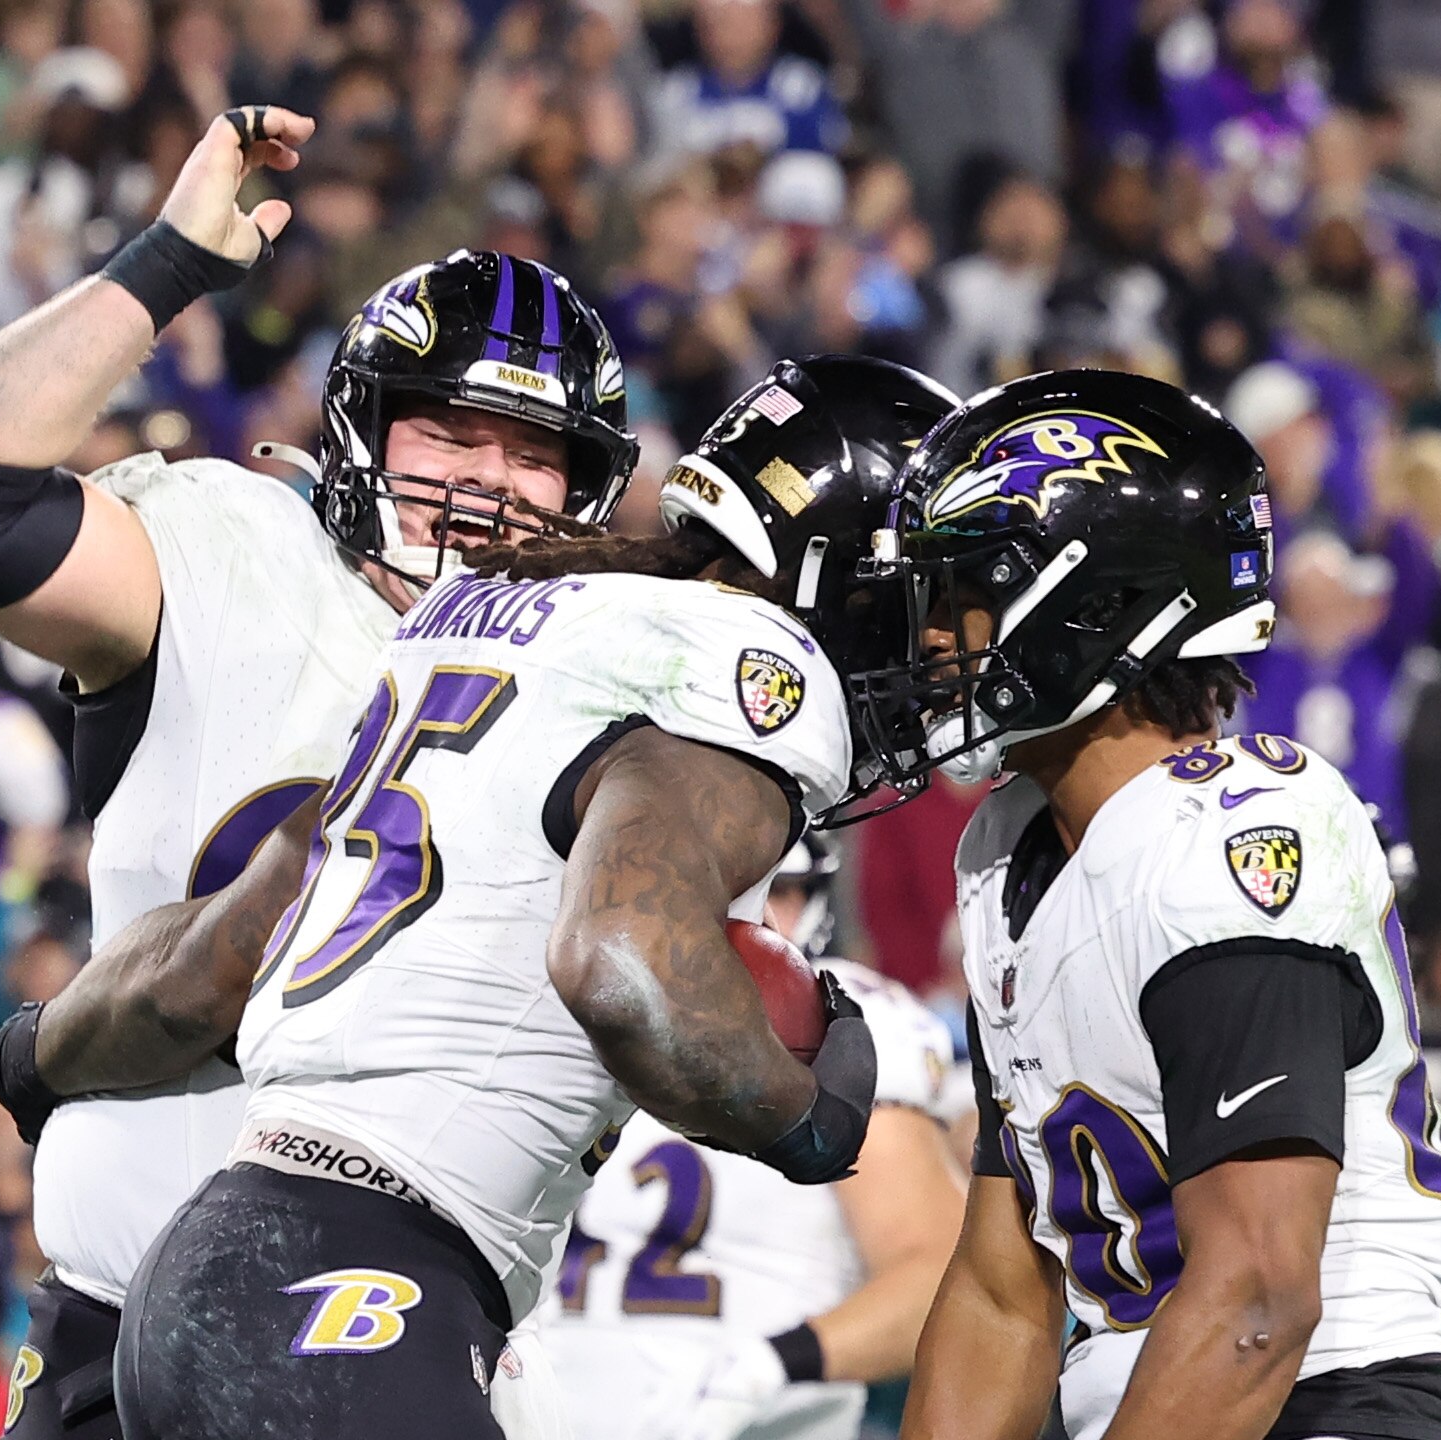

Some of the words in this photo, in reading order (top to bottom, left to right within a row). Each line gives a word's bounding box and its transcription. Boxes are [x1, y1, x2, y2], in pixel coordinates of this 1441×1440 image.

[496, 365, 547, 392] RAVENS
[745, 650, 801, 684] RAVENS
[1228, 829, 1295, 848] RAVENS
[999, 1080, 1185, 1333] 0
[278, 1267, 423, 1356] B
